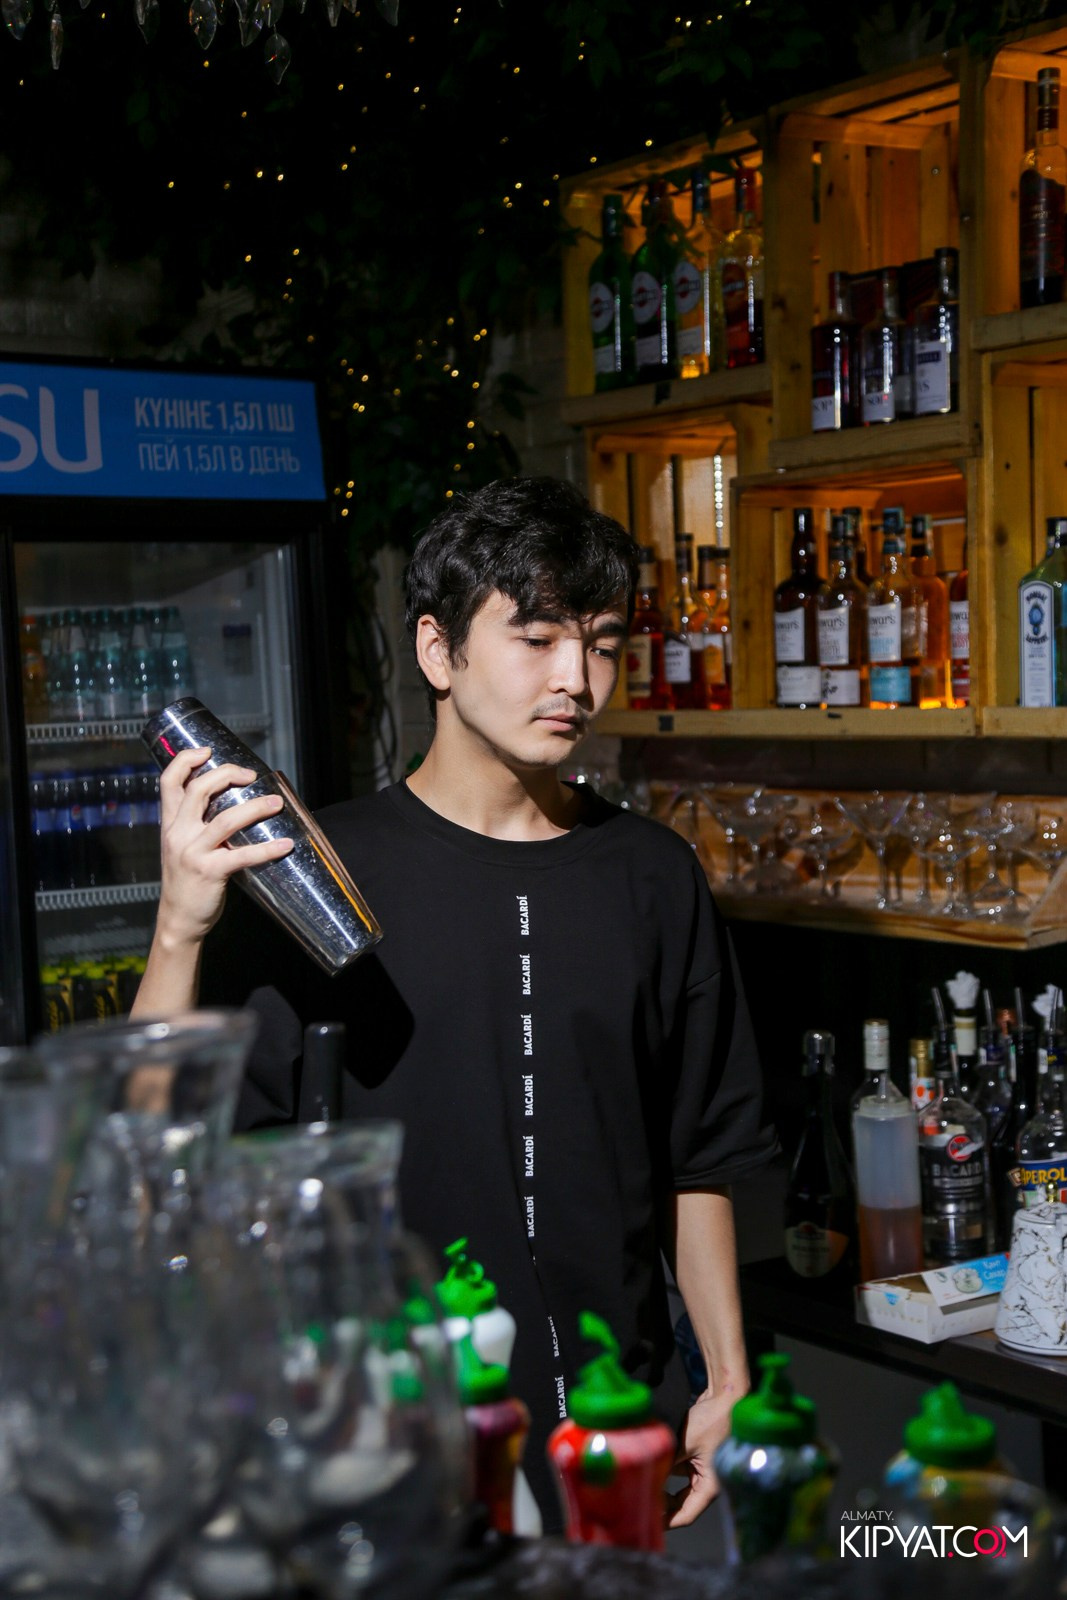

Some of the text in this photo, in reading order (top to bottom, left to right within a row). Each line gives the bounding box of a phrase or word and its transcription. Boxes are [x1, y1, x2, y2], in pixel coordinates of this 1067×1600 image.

[0, 383, 104, 474] SU
[134, 396, 215, 430] КҮНІНЕ
[217, 400, 264, 434] 1,5Л
[137, 439, 301, 476] ПЕЙ 1,5Л В ДЕНЬ
